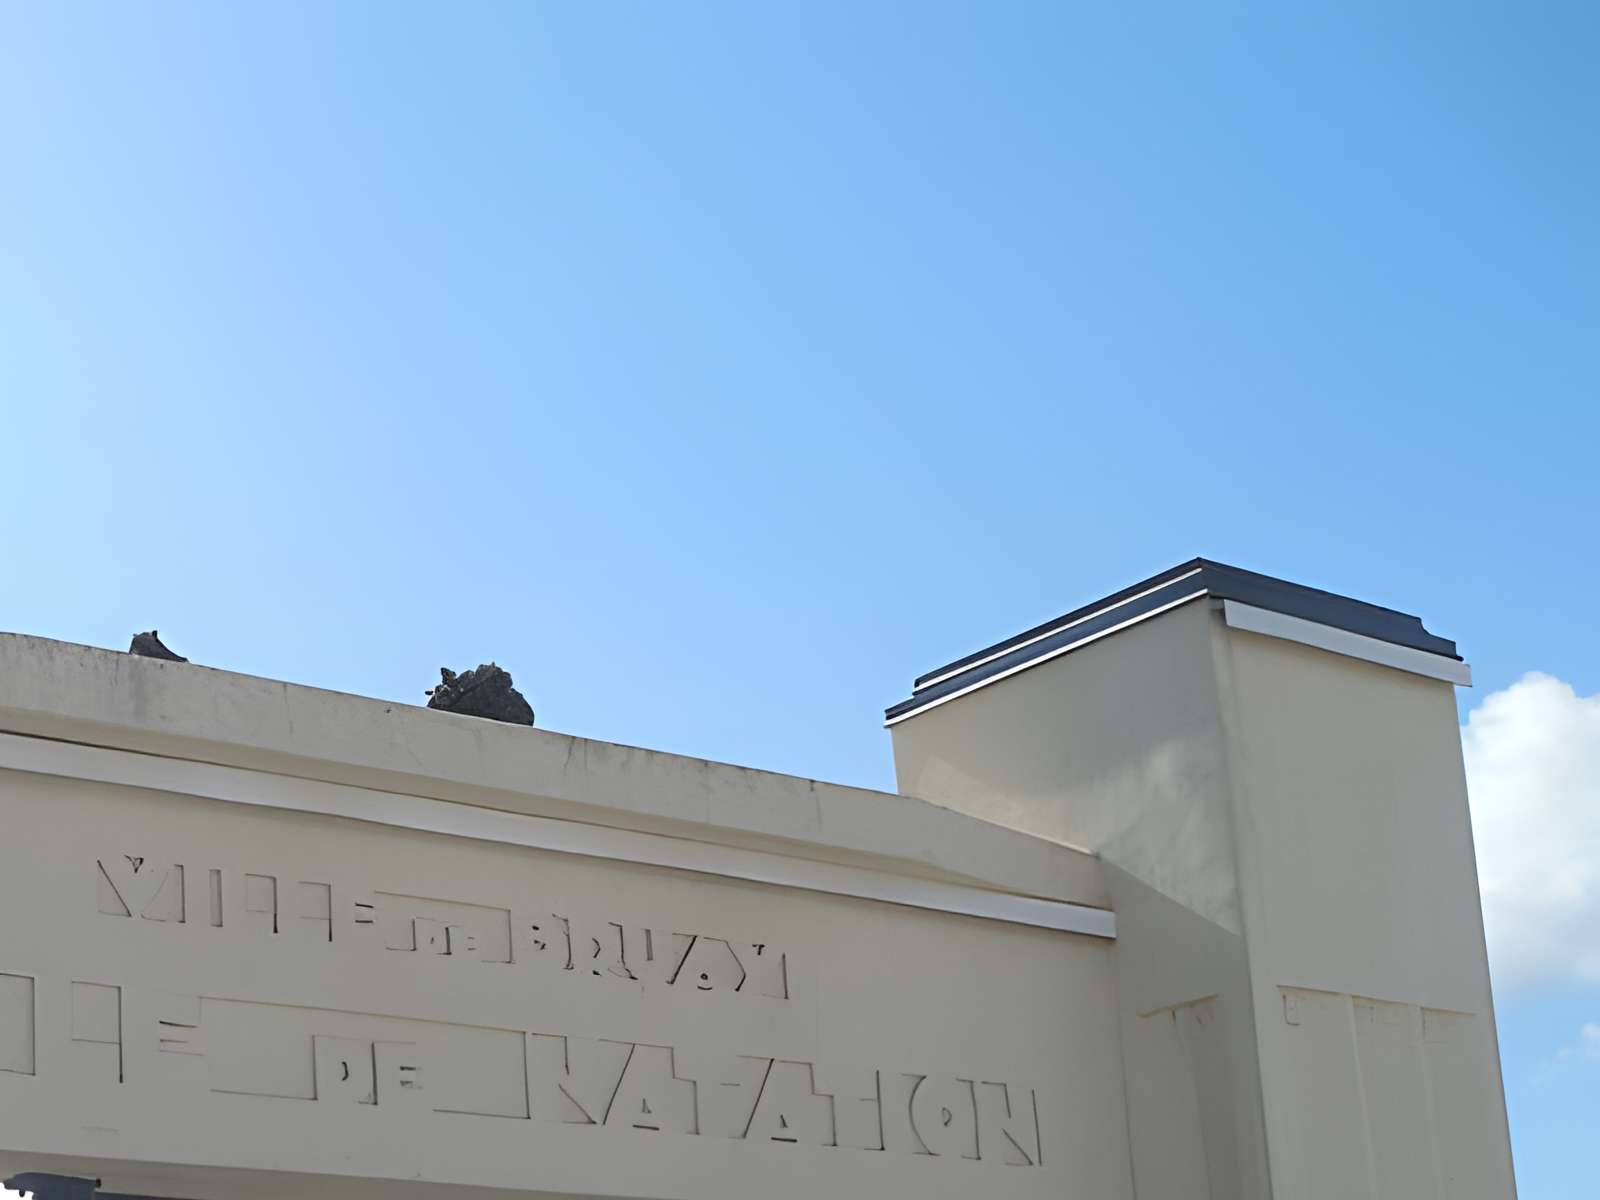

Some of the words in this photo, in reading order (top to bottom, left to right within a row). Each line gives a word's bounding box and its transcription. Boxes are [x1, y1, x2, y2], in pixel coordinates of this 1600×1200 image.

[96, 853, 382, 949] VILLE
[413, 915, 481, 960] DE
[510, 908, 788, 1001] BRUAY
[312, 1032, 434, 1112] DE
[525, 1031, 1044, 1168] NATATION
